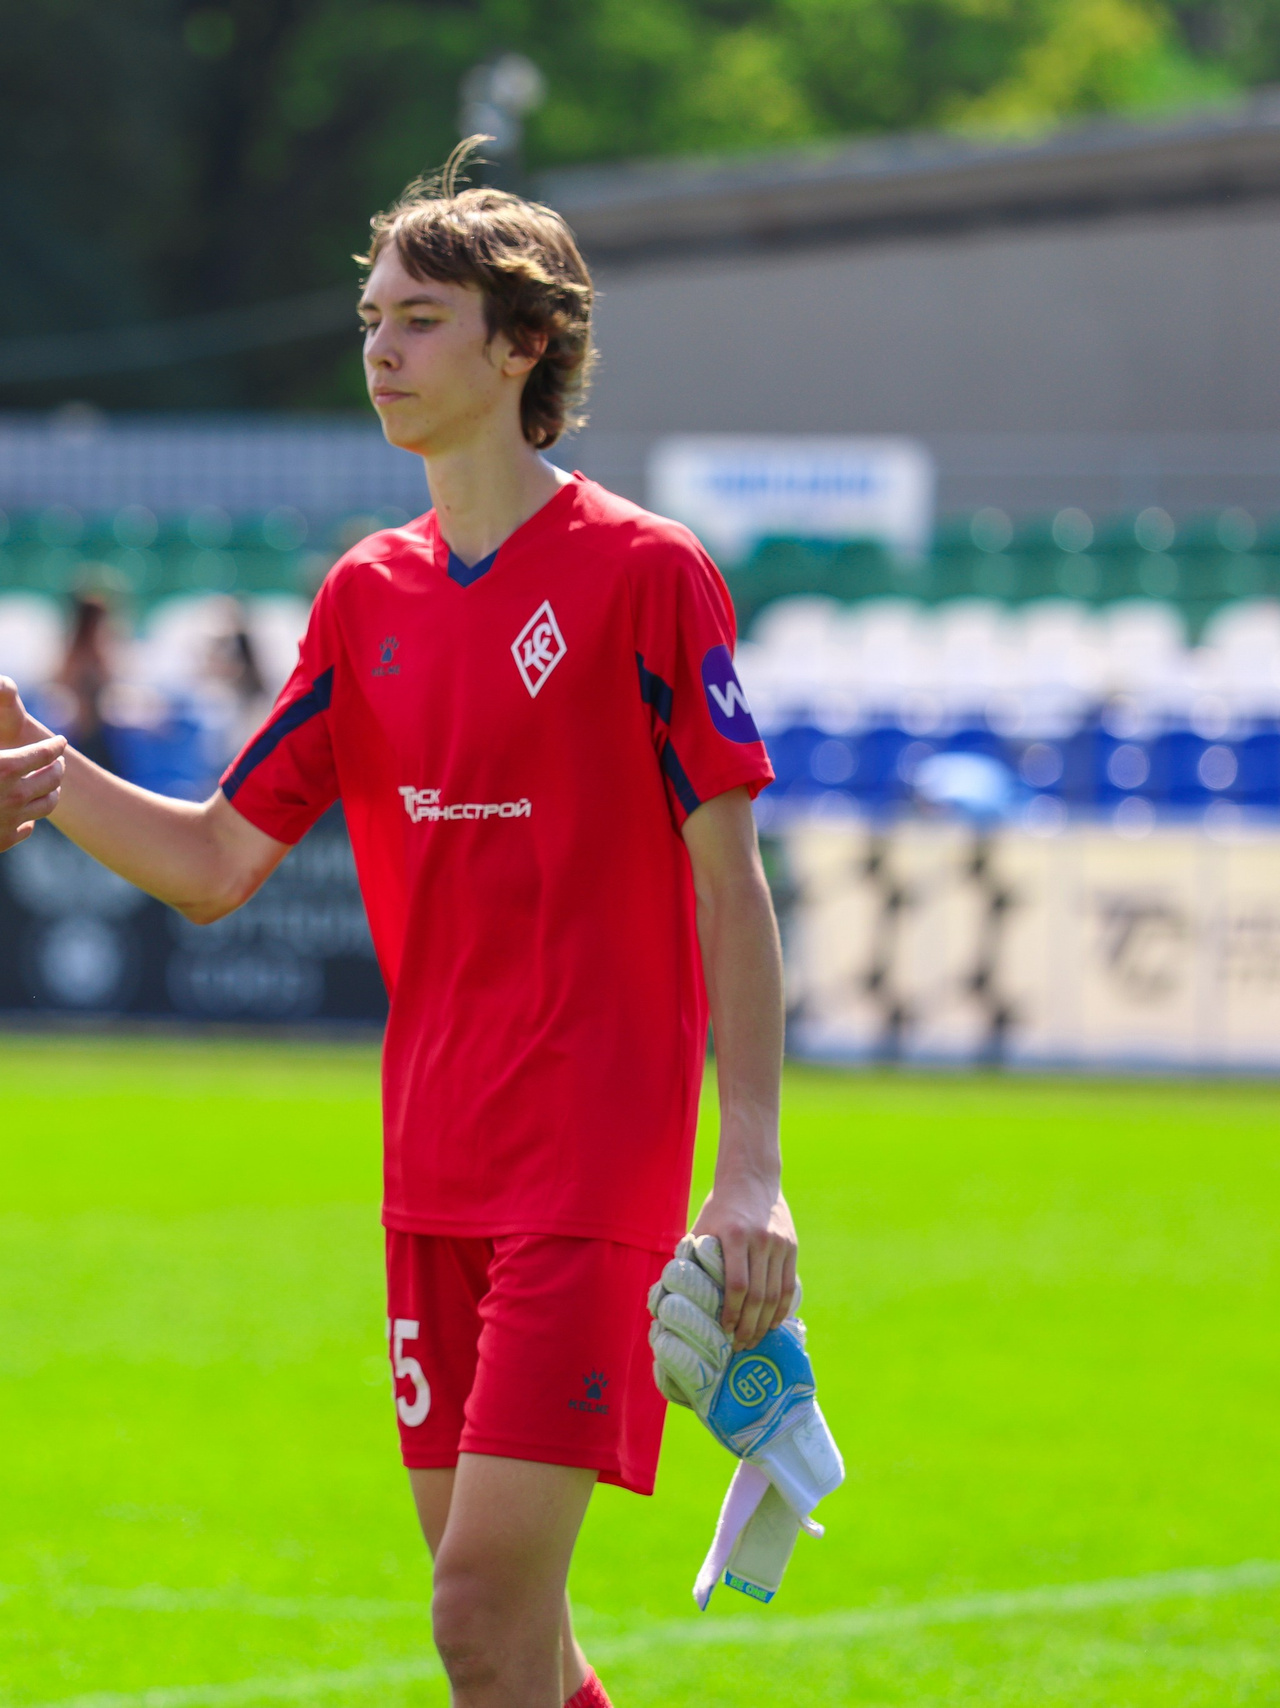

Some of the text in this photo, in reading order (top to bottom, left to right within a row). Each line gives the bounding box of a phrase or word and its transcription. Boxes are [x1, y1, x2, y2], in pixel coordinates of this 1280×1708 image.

[385, 1317, 431, 1428] 5
[568, 1400, 609, 1415] KELME
[730, 1576, 744, 1591] BE
